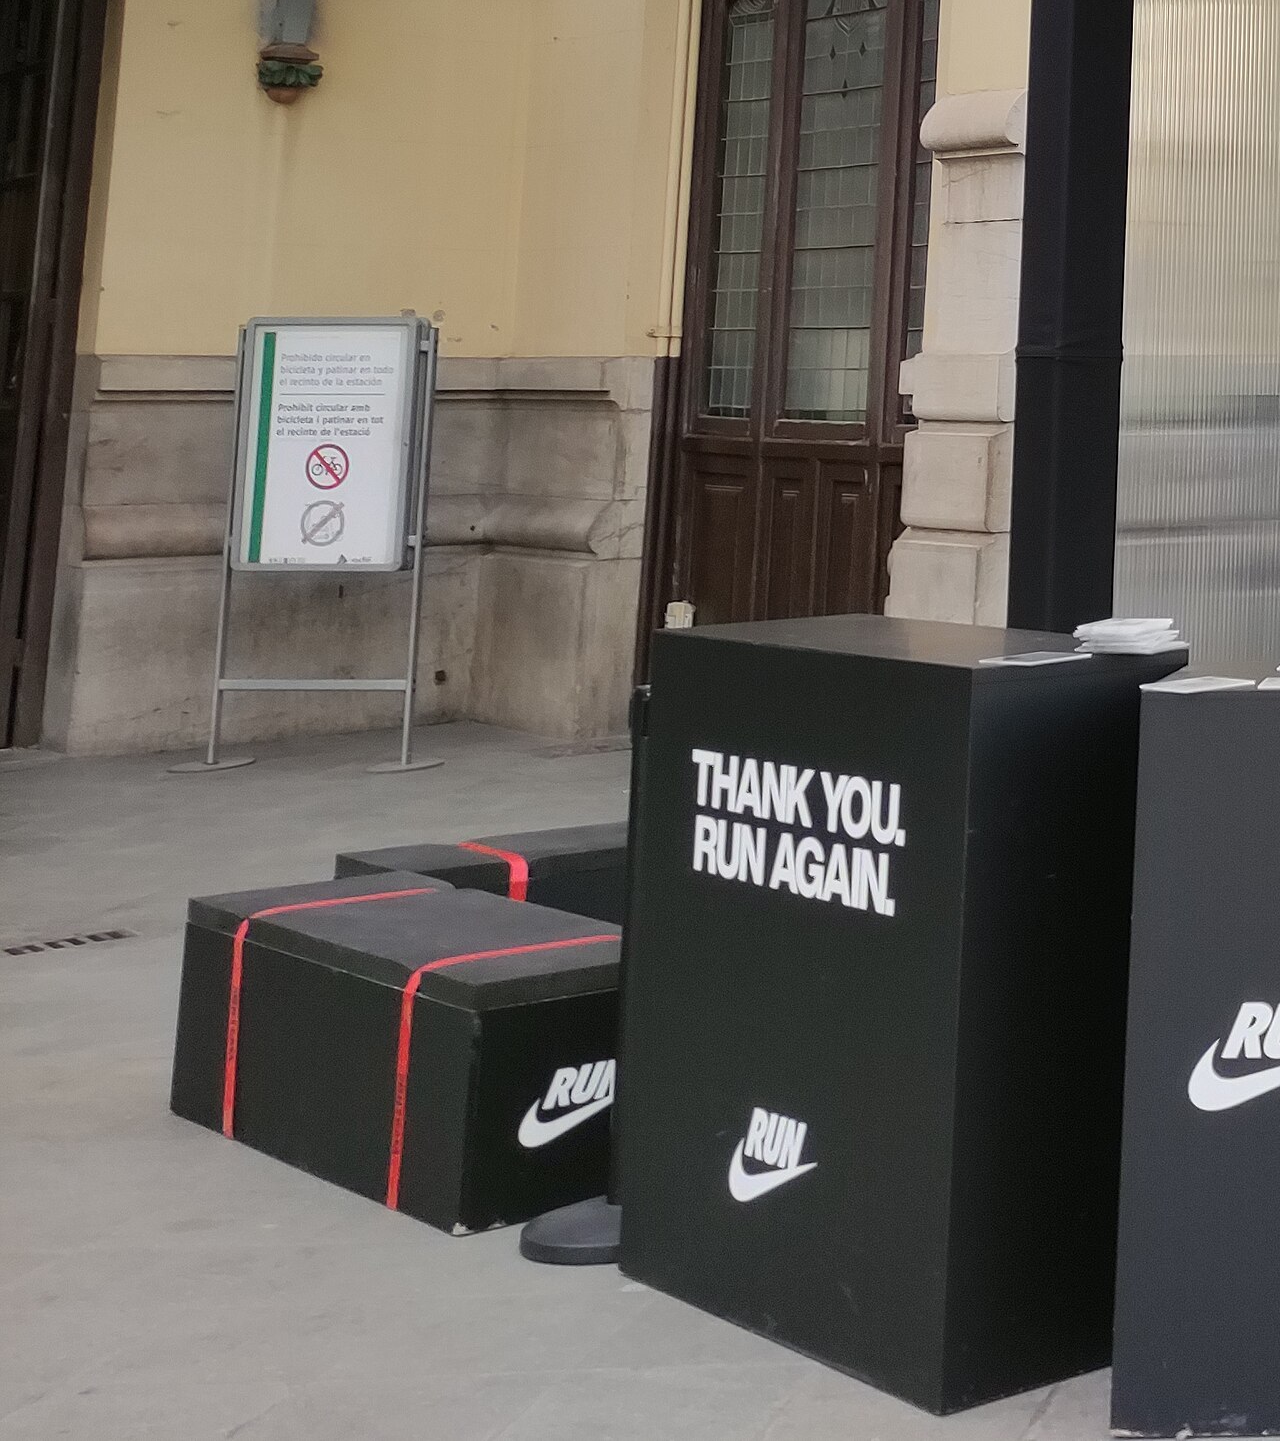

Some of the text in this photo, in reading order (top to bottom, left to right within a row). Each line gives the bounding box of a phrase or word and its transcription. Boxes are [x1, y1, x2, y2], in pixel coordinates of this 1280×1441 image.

[281, 353, 323, 362] Prohibido
[325, 353, 357, 362] circular
[280, 365, 316, 374] bicicleta
[326, 365, 357, 376] patinar
[374, 366, 395, 374] todo
[279, 378, 382, 386] el recinto de la estación
[278, 403, 370, 412] Prohibit circular amb
[276, 416, 314, 424] bicicleta
[322, 416, 355, 426] patinar
[357, 417, 368, 425] en
[371, 416, 384, 424] tot
[276, 427, 285, 436] el
[287, 427, 318, 436] recinte
[320, 427, 332, 436] de
[692, 748, 906, 847] THANK YOU.
[693, 814, 895, 917] RUN AGAIN.
[744, 1107, 807, 1169] RUN
